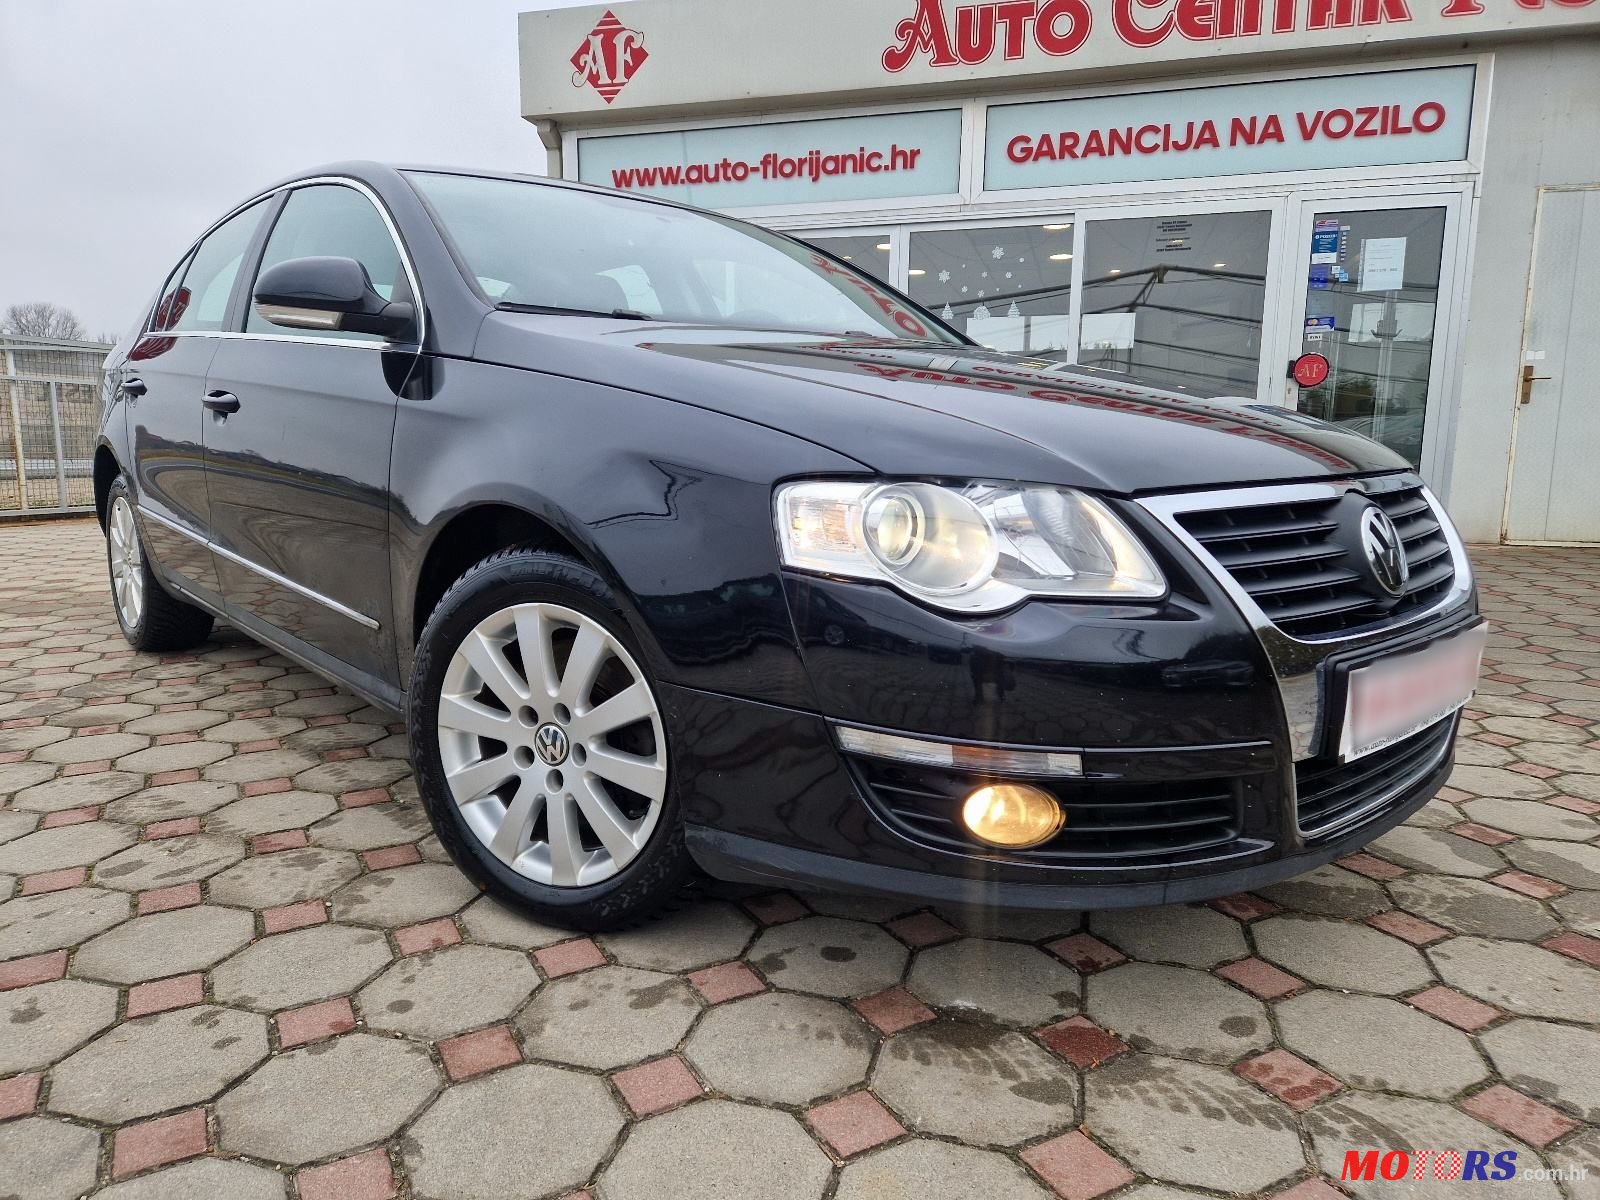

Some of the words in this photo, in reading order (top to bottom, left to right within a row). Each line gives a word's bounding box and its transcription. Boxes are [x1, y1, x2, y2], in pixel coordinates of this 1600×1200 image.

[881, 0, 1093, 72] AUTO
[1006, 119, 1220, 163] GARANCIJA
[1229, 114, 1285, 147] NA
[1296, 101, 1447, 141] VOZILO
[612, 144, 921, 188] www.auto-florijanic.hr
